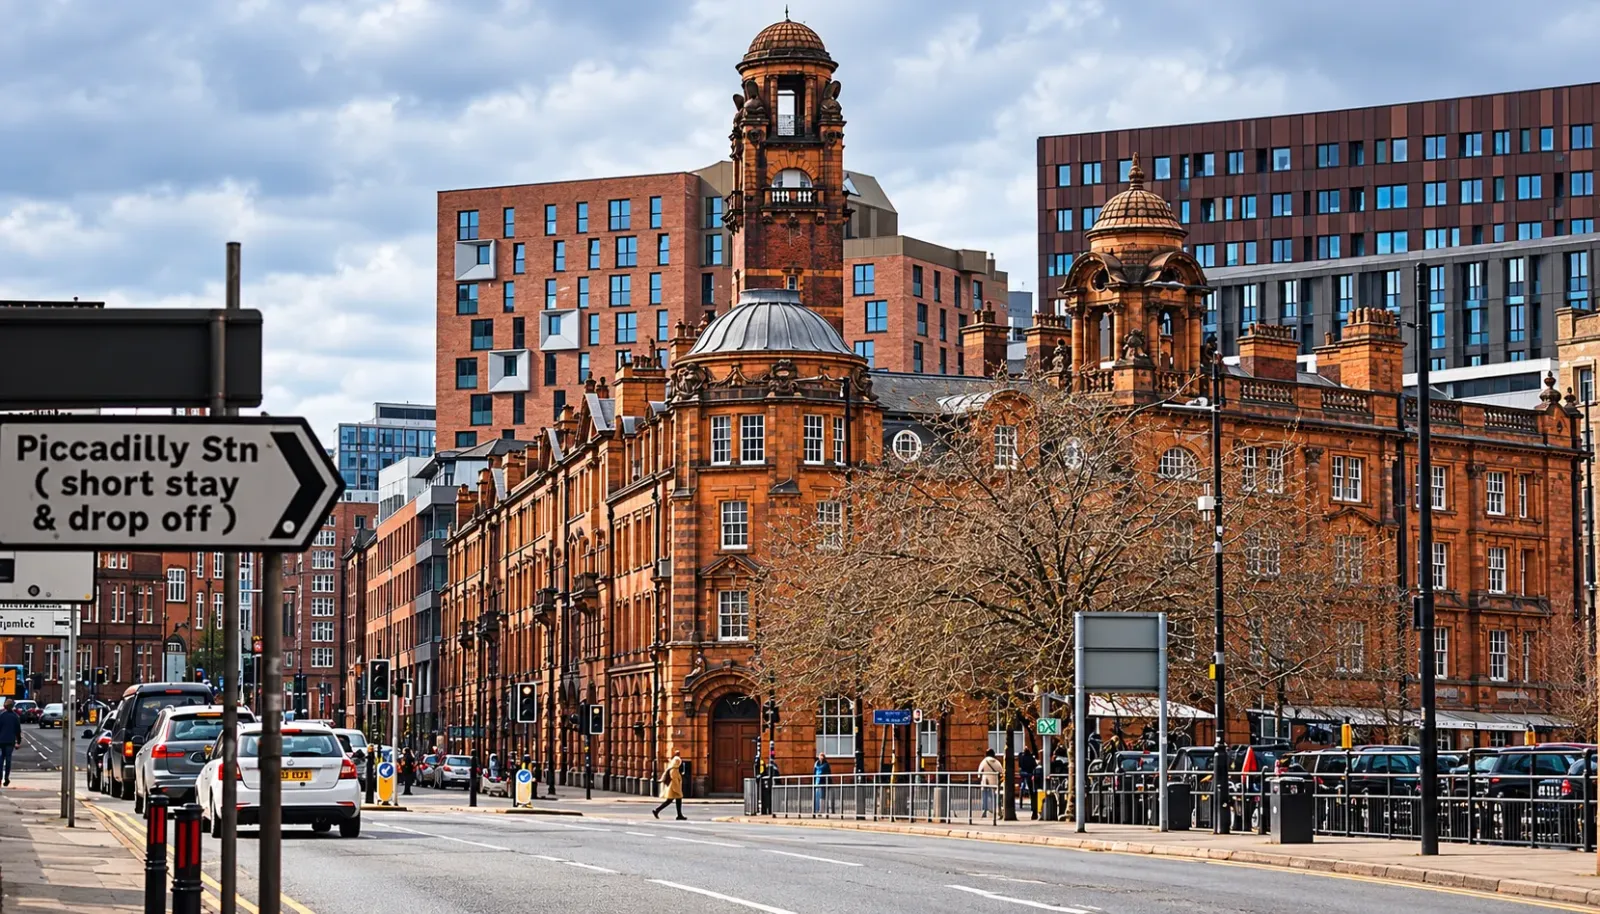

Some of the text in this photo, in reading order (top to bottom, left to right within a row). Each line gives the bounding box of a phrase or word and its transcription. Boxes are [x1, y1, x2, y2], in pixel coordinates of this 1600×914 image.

[16, 433, 259, 469] Piccadilly Stn
[60, 470, 154, 497] short
[165, 470, 240, 503] stay
[32, 503, 57, 531] &
[68, 503, 149, 538] drop
[161, 504, 213, 532] off
